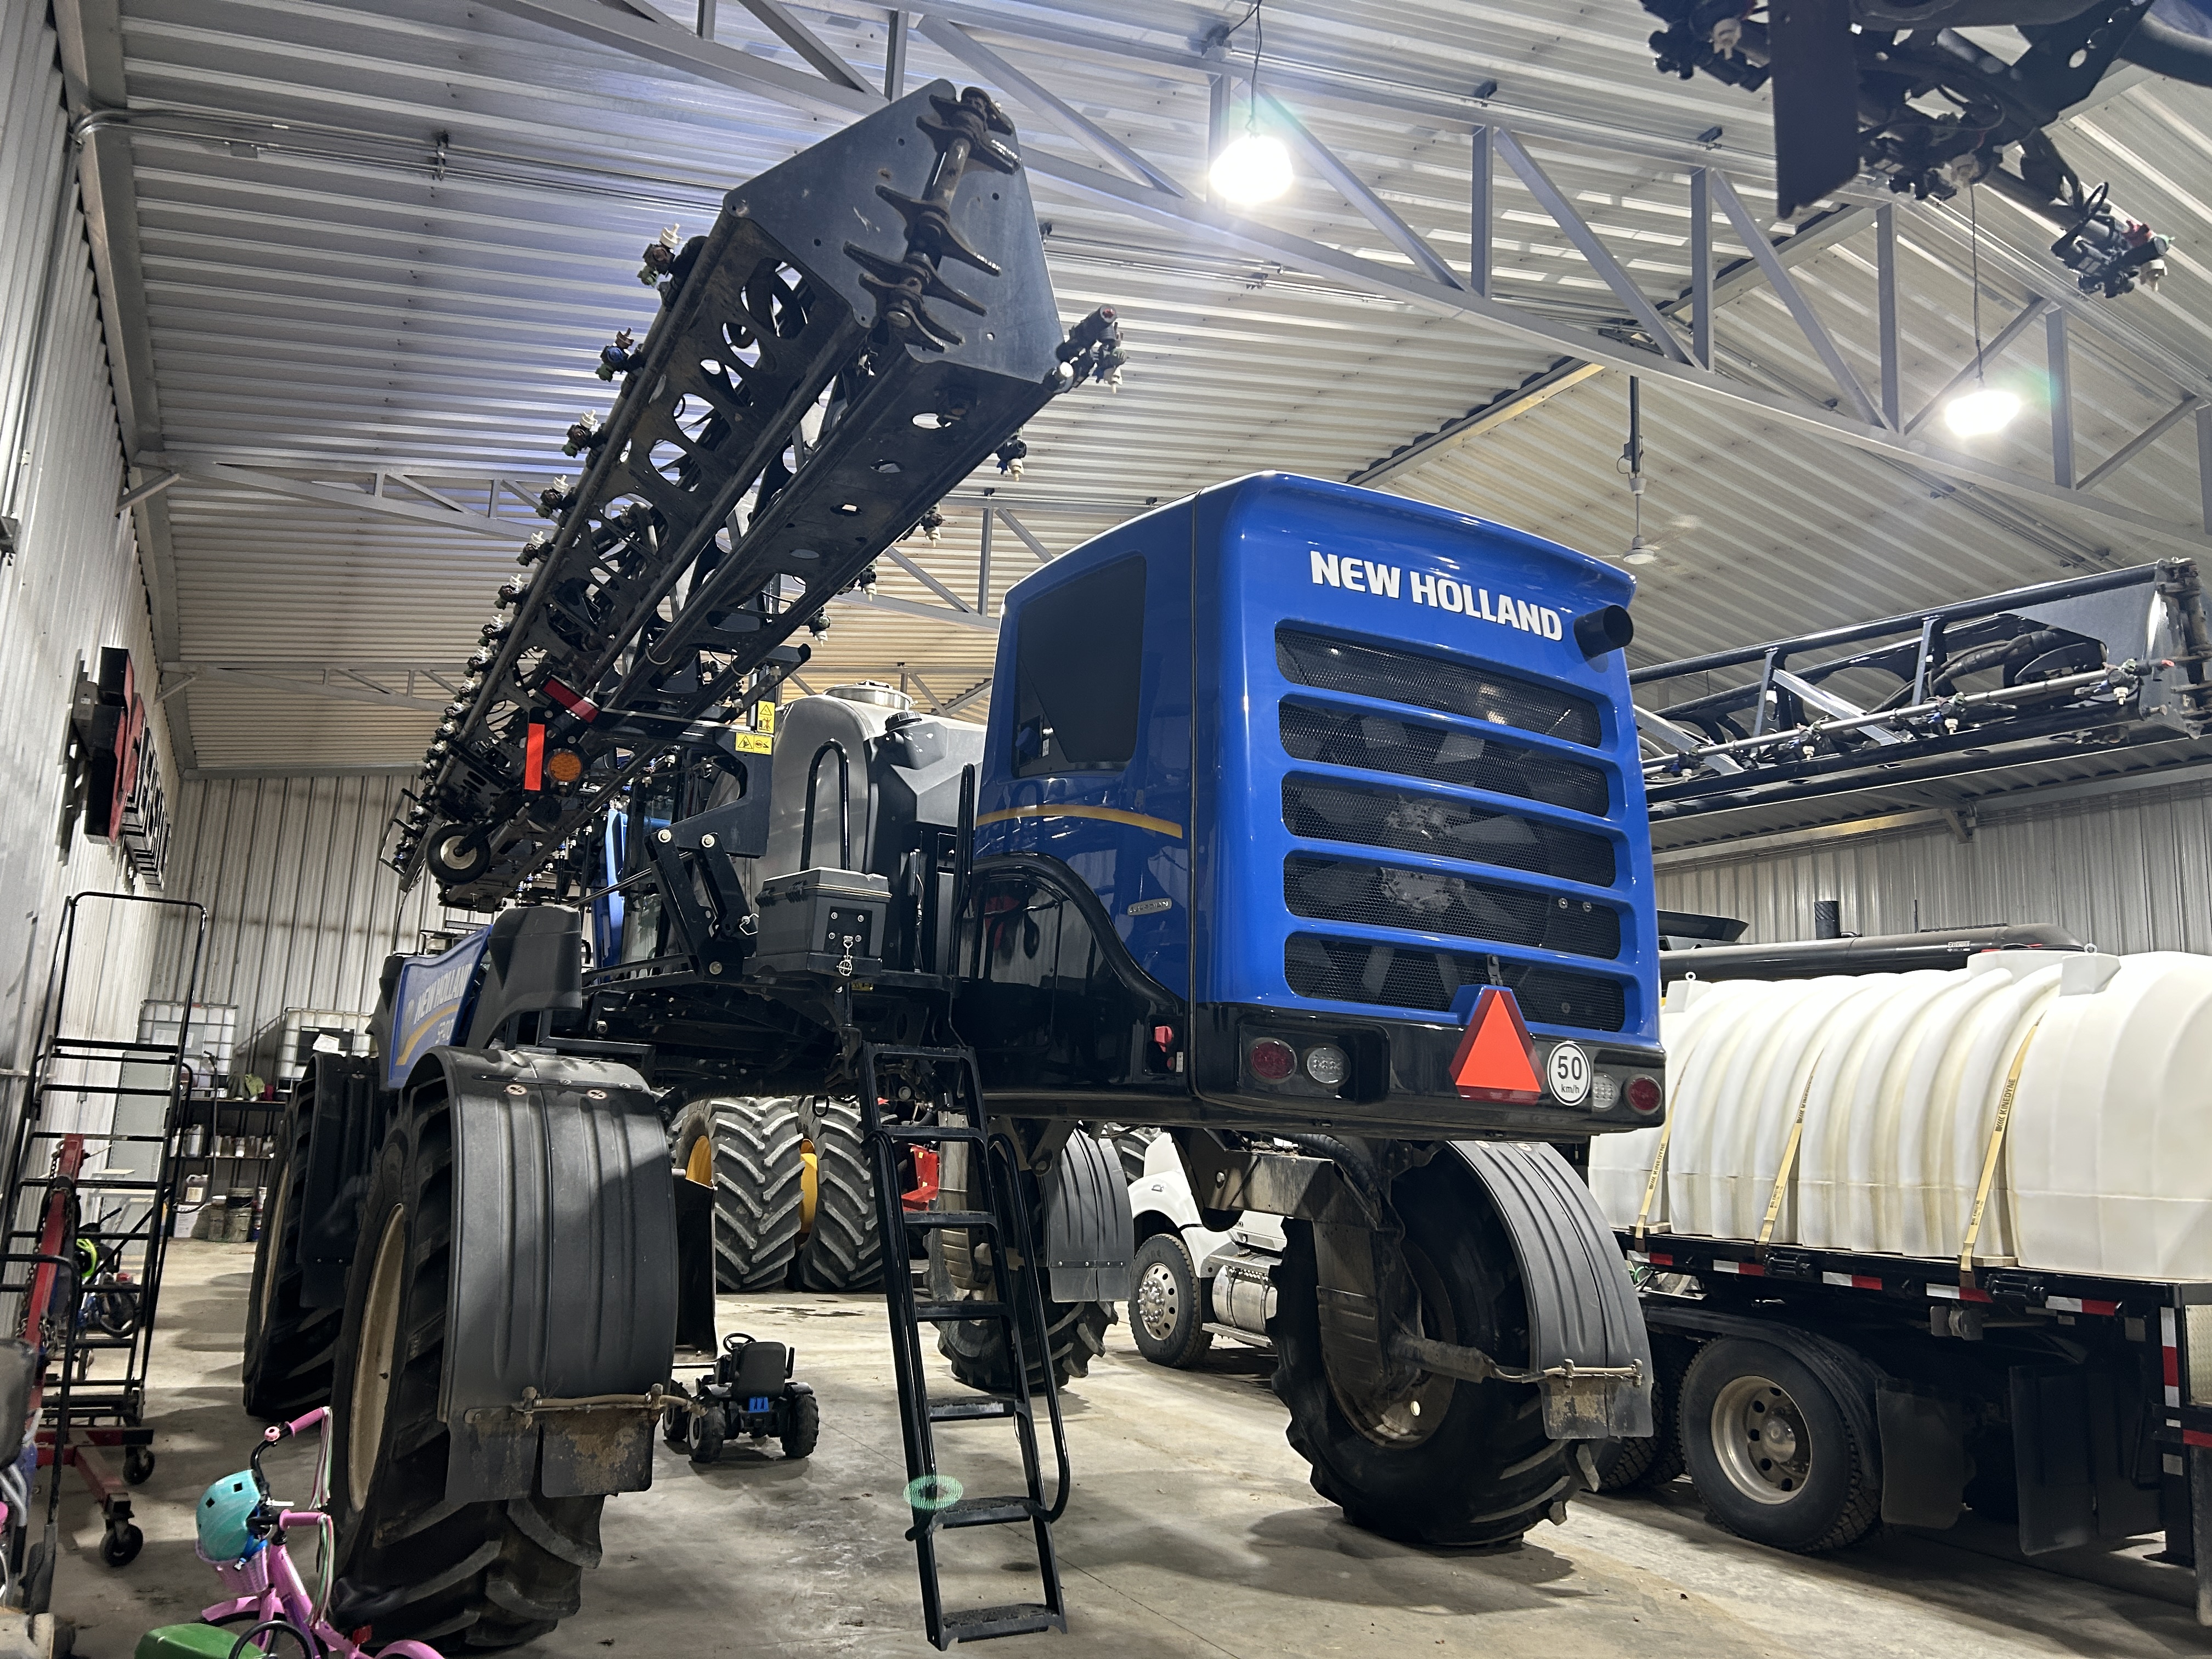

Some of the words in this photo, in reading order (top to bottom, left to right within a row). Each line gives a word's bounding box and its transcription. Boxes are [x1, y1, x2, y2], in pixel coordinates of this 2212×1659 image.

[1310, 550, 1401, 599] NEW
[1410, 571, 1562, 641] HOLLAND
[414, 980, 437, 1025] NEW
[1558, 1056, 1582, 1080] 50
[1561, 1084, 1580, 1093] km/h
[2000, 1079, 2016, 1115] KINEDYNE
[1653, 1143, 1666, 1175] KINEDYNE
